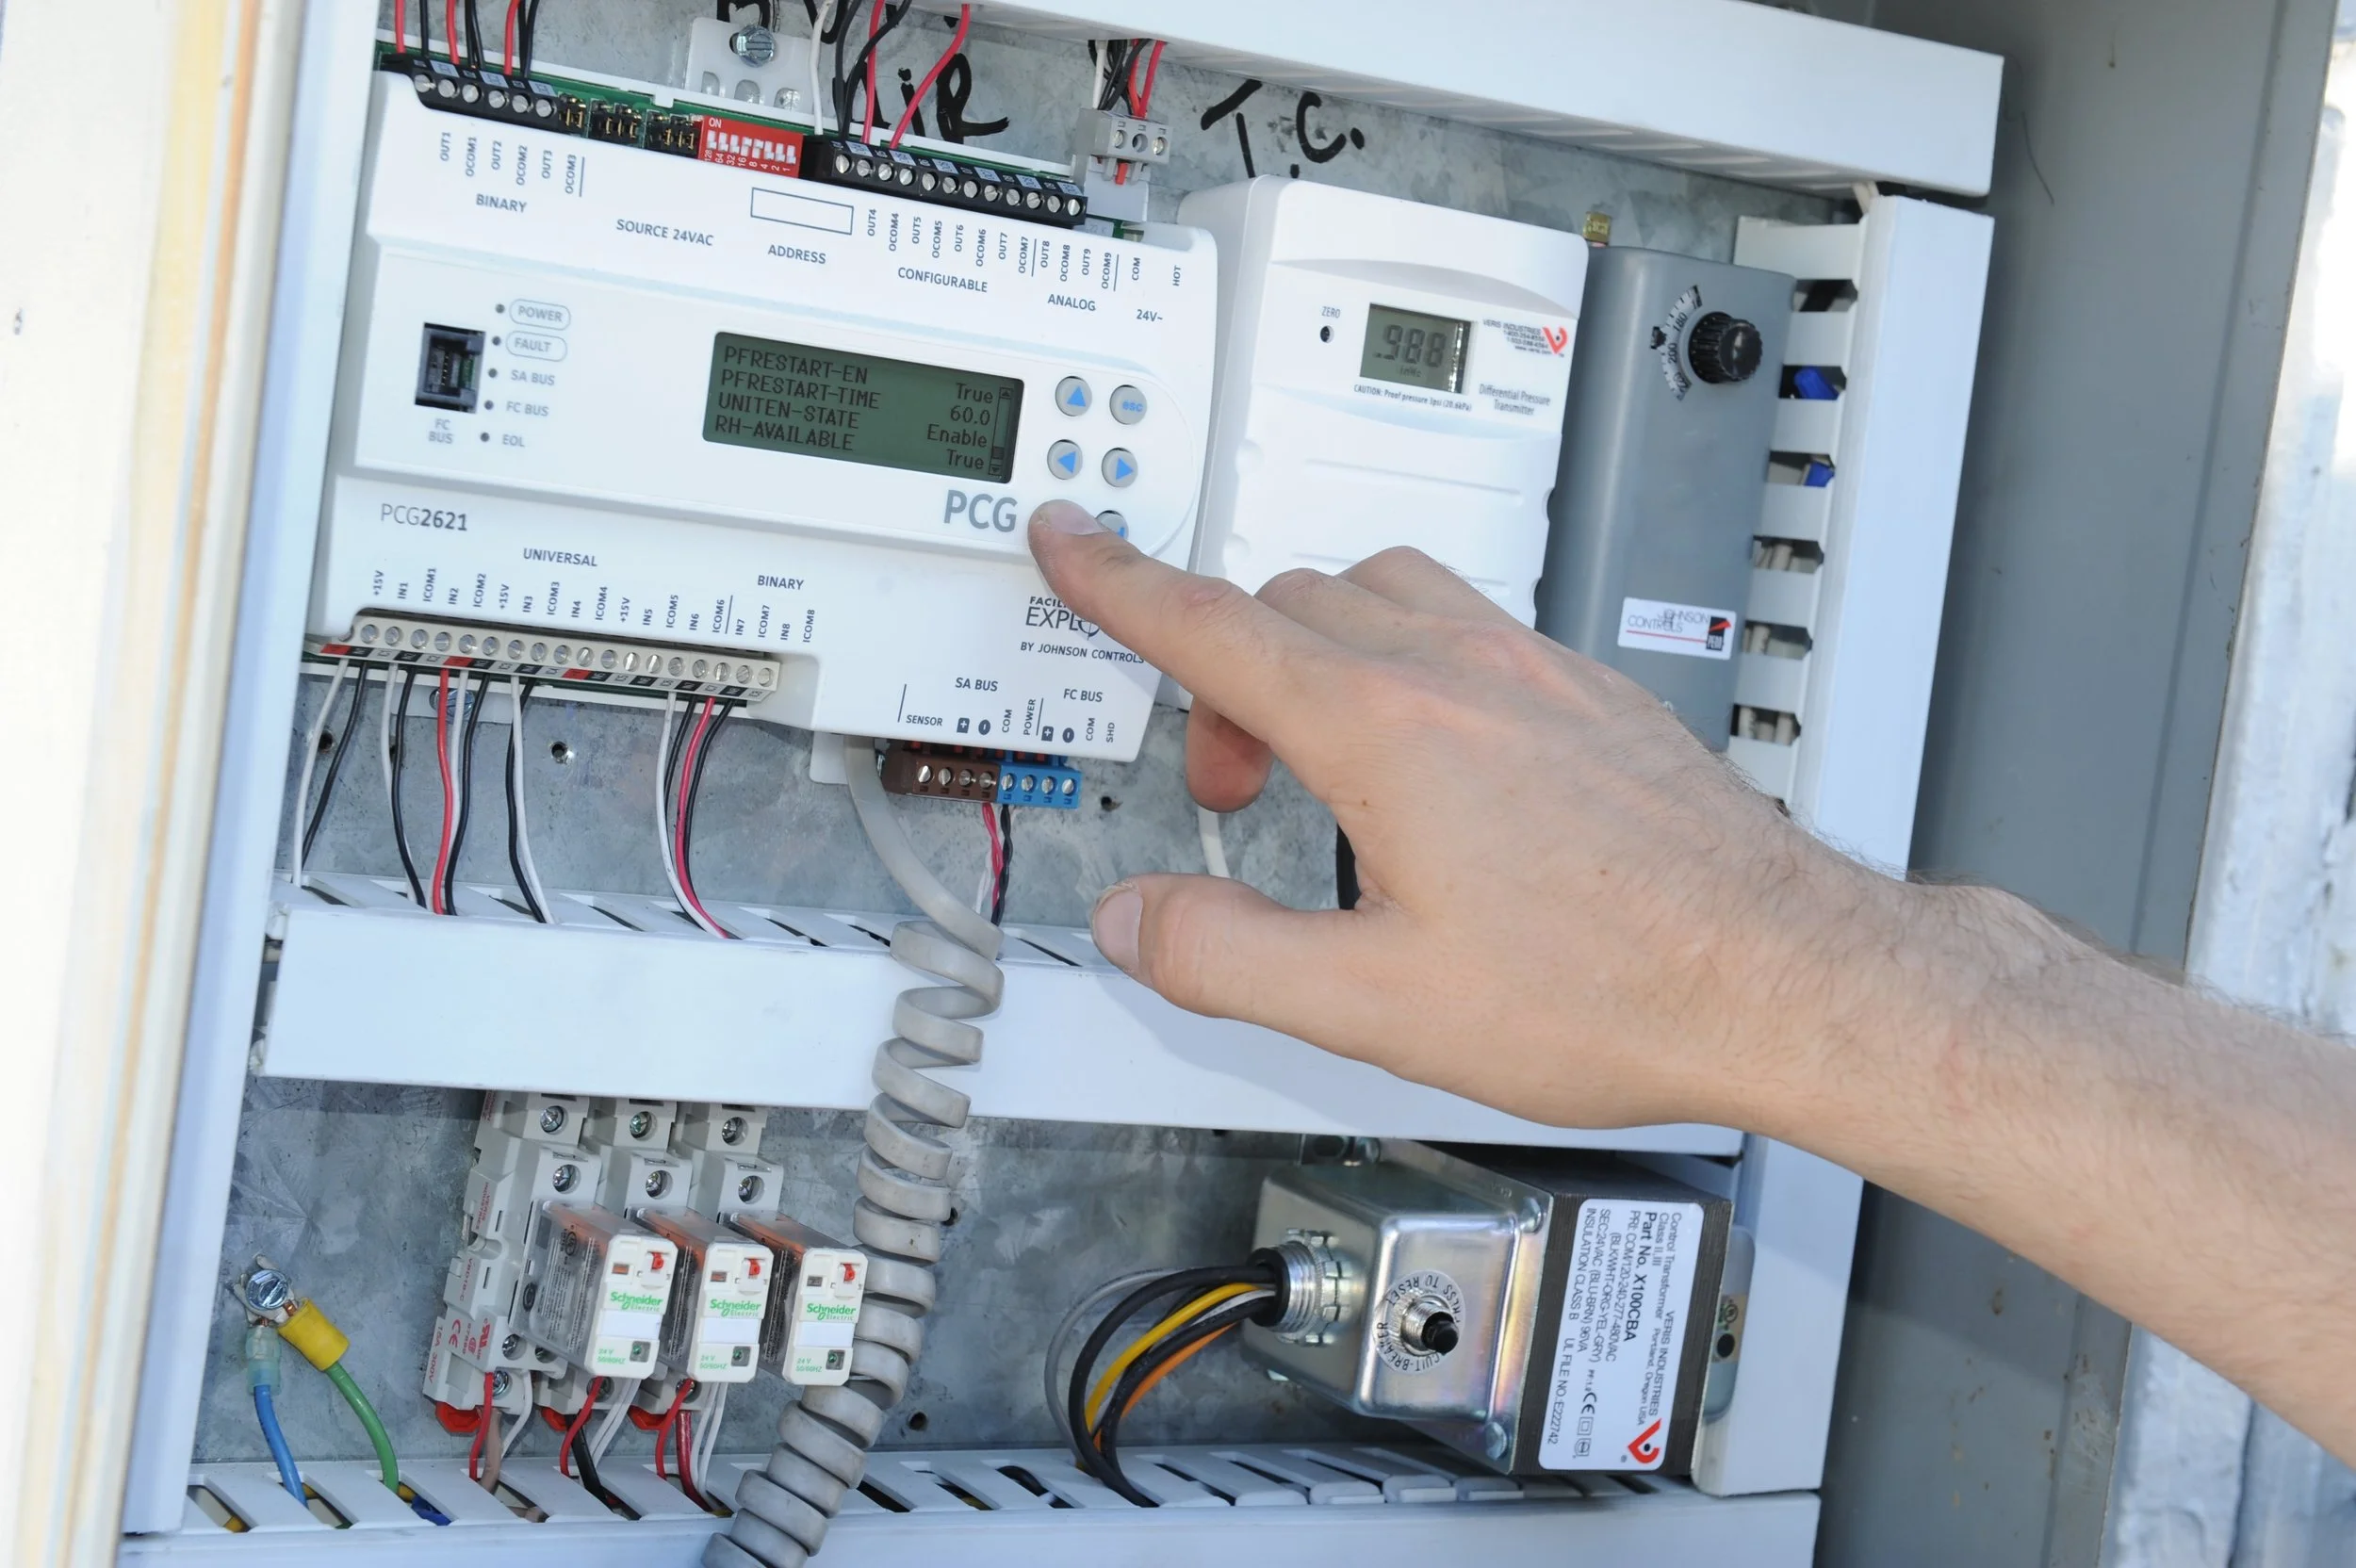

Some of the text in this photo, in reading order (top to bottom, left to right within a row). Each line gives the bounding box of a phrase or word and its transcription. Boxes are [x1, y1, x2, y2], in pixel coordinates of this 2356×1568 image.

[709, 117, 722, 128] ON
[440, 131, 451, 162] OUT1
[466, 137, 478, 177] OCOM1
[491, 140, 502, 171] OUT2
[714, 153, 724, 164] 64
[515, 145, 529, 186] OCOM2
[542, 149, 553, 179] OUT3
[727, 155, 735, 166] 32
[738, 156, 747, 167] 16
[564, 154, 577, 194] OCOM3
[475, 192, 528, 214] BINARY
[615, 218, 714, 247] SOURCE 24VAC
[867, 208, 877, 237] OUT4
[889, 212, 900, 253] OCOM4
[911, 216, 923, 245] OUT5
[931, 220, 943, 259] OCOM5
[955, 223, 965, 253] OUT6
[975, 228, 987, 268] OCOM6
[998, 232, 1008, 261] OUT7
[768, 243, 826, 265] ADDRESS
[1018, 236, 1029, 274] OCOM7
[1040, 240, 1051, 270] OUT8
[1059, 244, 1071, 283] OCOM8
[1081, 248, 1091, 277] OUT9
[897, 267, 989, 294] CONFIGURABLE
[1101, 252, 1112, 290] OCOM9
[1131, 256, 1141, 282] COM
[1172, 265, 1182, 286] HOT
[518, 305, 563, 322] POWER
[1047, 293, 1097, 313] ANALOG
[1321, 306, 1341, 318] ZERO
[515, 337, 551, 352] FAULT
[1667, 342, 1677, 365] 200
[511, 369, 555, 386] SA BUS
[724, 345, 994, 403] PFRESTART-EN True
[721, 368, 990, 426] PFRESTART-TIME 60.0
[1353, 384, 1383, 397] CAUTION:
[1479, 384, 1551, 406] Differential Pressure
[506, 400, 549, 417] FC BUS
[1121, 400, 1144, 413] esc
[1493, 399, 1535, 416] Transmitter
[718, 392, 988, 449] UNITEN-STATE Enable
[429, 431, 453, 445] BUS
[502, 434, 525, 448] EOL
[714, 415, 984, 470] RH-AVAILABLE True
[380, 502, 468, 531] PCG2621
[943, 489, 1018, 532] PCG
[523, 547, 598, 568] UNIVERSAL
[399, 581, 409, 600] IN1
[423, 566, 437, 603] ICOM1
[472, 572, 487, 609] ICOM2
[757, 574, 805, 592] BINARY
[449, 587, 459, 606] IN2
[523, 596, 533, 613] IN3
[547, 580, 561, 616] ICOM3
[596, 586, 609, 622] ICOM4
[1029, 596, 1067, 609] FACIL
[570, 600, 581, 619] IN4
[643, 608, 653, 627] IN5
[665, 594, 679, 629] ICOM5
[689, 612, 700, 631] IN6
[712, 598, 726, 634] ICOM6
[758, 604, 771, 639] ICOM7
[735, 617, 746, 636] IN7
[780, 623, 791, 641] IN8
[802, 609, 816, 644] ICOM8
[1021, 642, 1035, 652] BY
[1038, 644, 1088, 658] JOHNSON
[955, 677, 999, 693] SA BUS
[1063, 688, 1104, 703] FC BUS
[906, 714, 943, 727] SENSOR
[1001, 709, 1012, 733] COM
[1023, 698, 1037, 736] POWER
[1085, 717, 1096, 742] COM
[1105, 722, 1116, 743] SHD
[1577, 1208, 1596, 1272] INSULATION
[1656, 1213, 1669, 1244] Class
[1623, 1212, 1657, 1342] Part No. X100CBA
[1656, 1212, 1682, 1319] Control Transformer
[610, 1291, 663, 1310] Schneider
[1385, 1276, 1419, 1307] RESET
[1570, 1274, 1585, 1310] CLASS
[1580, 1269, 1601, 1324] (BLU-BRN)
[630, 1304, 661, 1313] Electric
[710, 1298, 761, 1317] Schneider
[807, 1302, 857, 1321] Schneider
[1562, 1338, 1576, 1351] UL
[1559, 1354, 1572, 1377] FILE
[1648, 1311, 1675, 1416] VERIS INDUSTRIES
[1581, 1392, 1596, 1414] CE
[1637, 1405, 1647, 1426] USA
